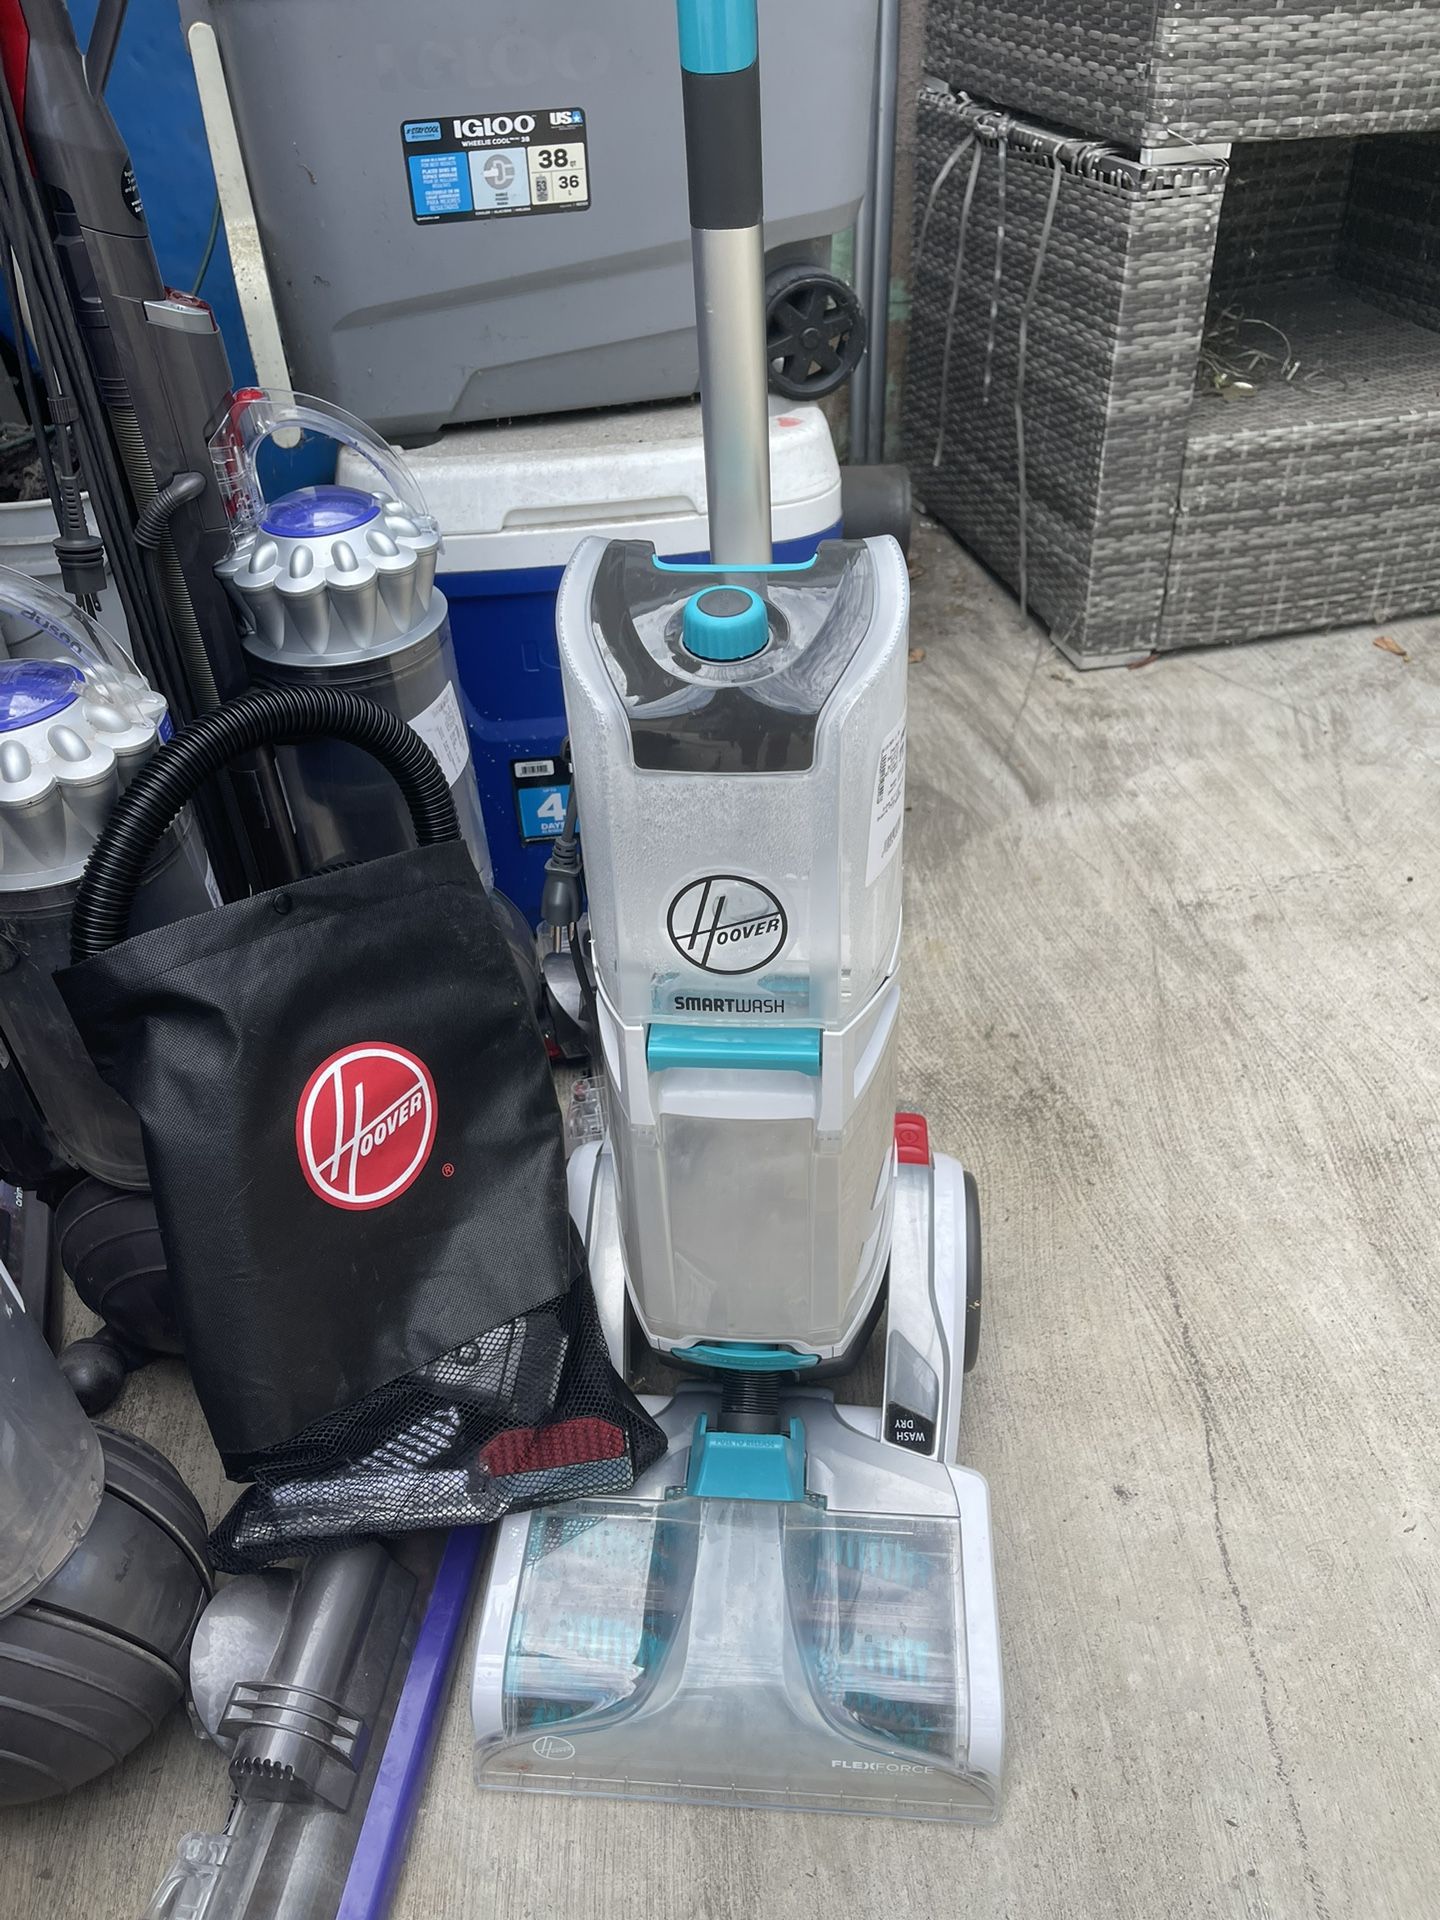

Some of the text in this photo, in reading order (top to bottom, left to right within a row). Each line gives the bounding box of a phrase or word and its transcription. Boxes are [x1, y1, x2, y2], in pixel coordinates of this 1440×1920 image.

[549, 111, 583, 125] USA
[453, 115, 536, 138] IGLOO
[461, 139, 491, 147] WHEELIE
[538, 149, 568, 168] 38
[559, 175, 579, 189] 36
[537, 793, 567, 821] 4
[541, 821, 565, 830] DAY
[674, 996, 785, 1013] SMARTWASH
[894, 1419, 914, 1429] DRY
[896, 1431, 925, 1442] WASH
[832, 1760, 936, 1775] FLEXFORCE
